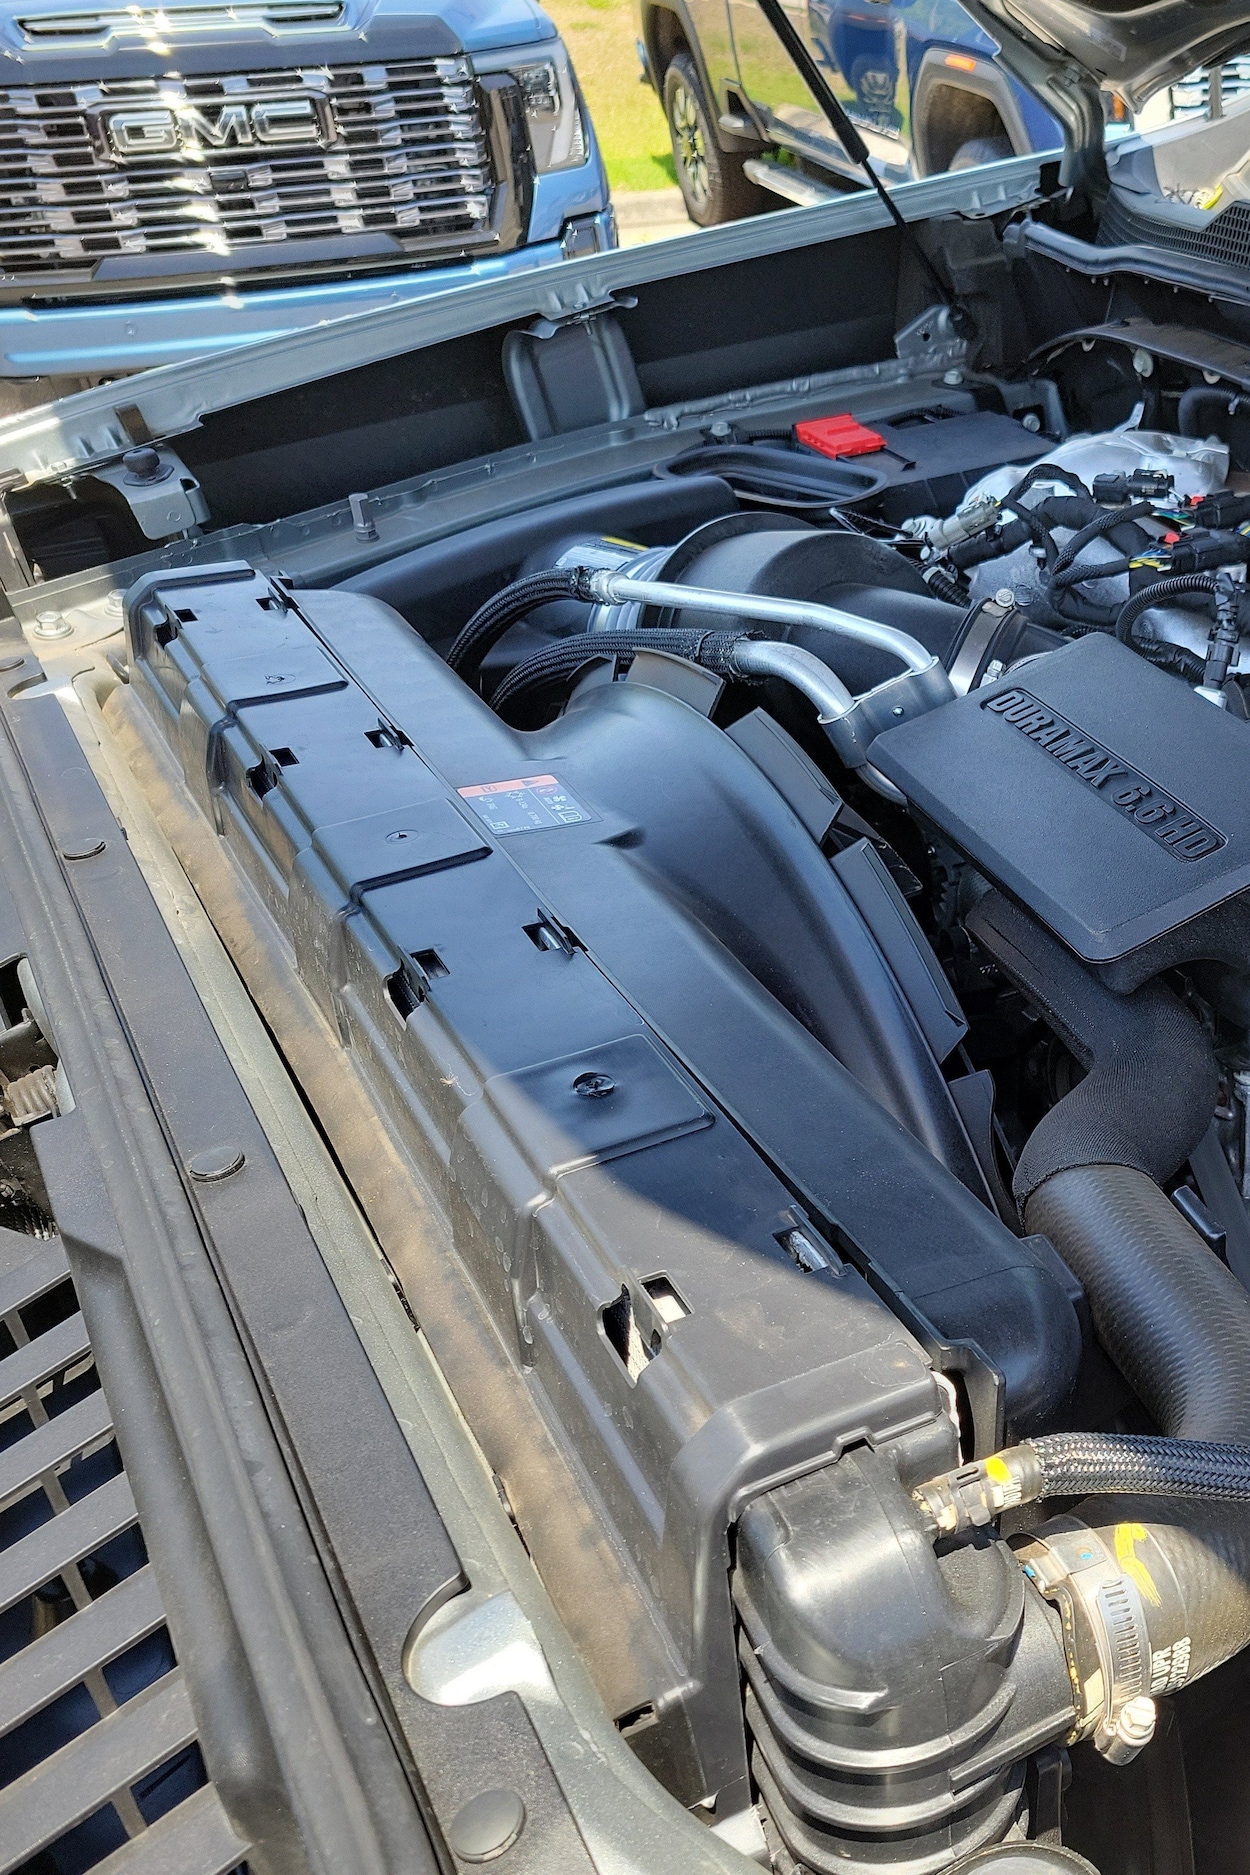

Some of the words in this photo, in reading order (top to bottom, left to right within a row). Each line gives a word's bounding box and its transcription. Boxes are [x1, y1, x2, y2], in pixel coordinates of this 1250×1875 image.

[109, 100, 318, 150] GMC
[987, 691, 1127, 789] DURAMAX
[1112, 782, 1175, 824] 6.6
[1155, 816, 1218, 858] HD
[1151, 1645, 1172, 1678] UPR
